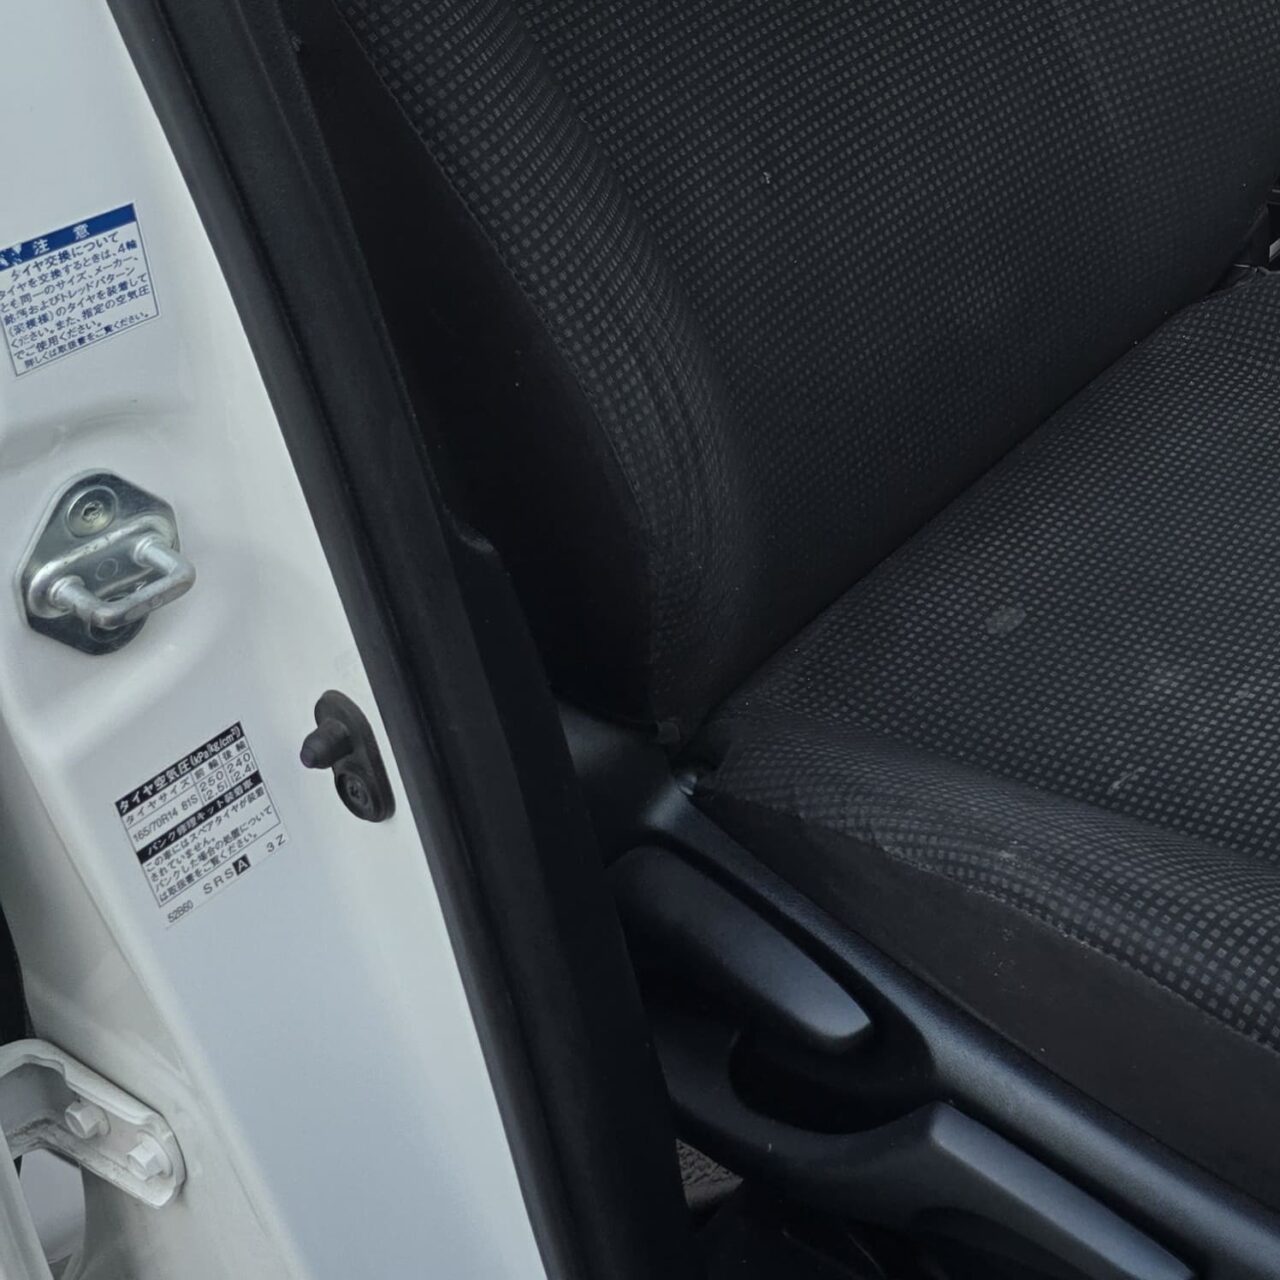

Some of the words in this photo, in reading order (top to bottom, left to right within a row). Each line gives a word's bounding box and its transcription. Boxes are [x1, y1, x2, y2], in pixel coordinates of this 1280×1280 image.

[33, 223, 91, 255] 注意
[196, 769, 225, 792] 250
[225, 751, 252, 774] 240
[123, 776, 191, 825] タイヤサイズ
[131, 807, 179, 843] 165/70R14
[148, 833, 216, 882] されていません。
